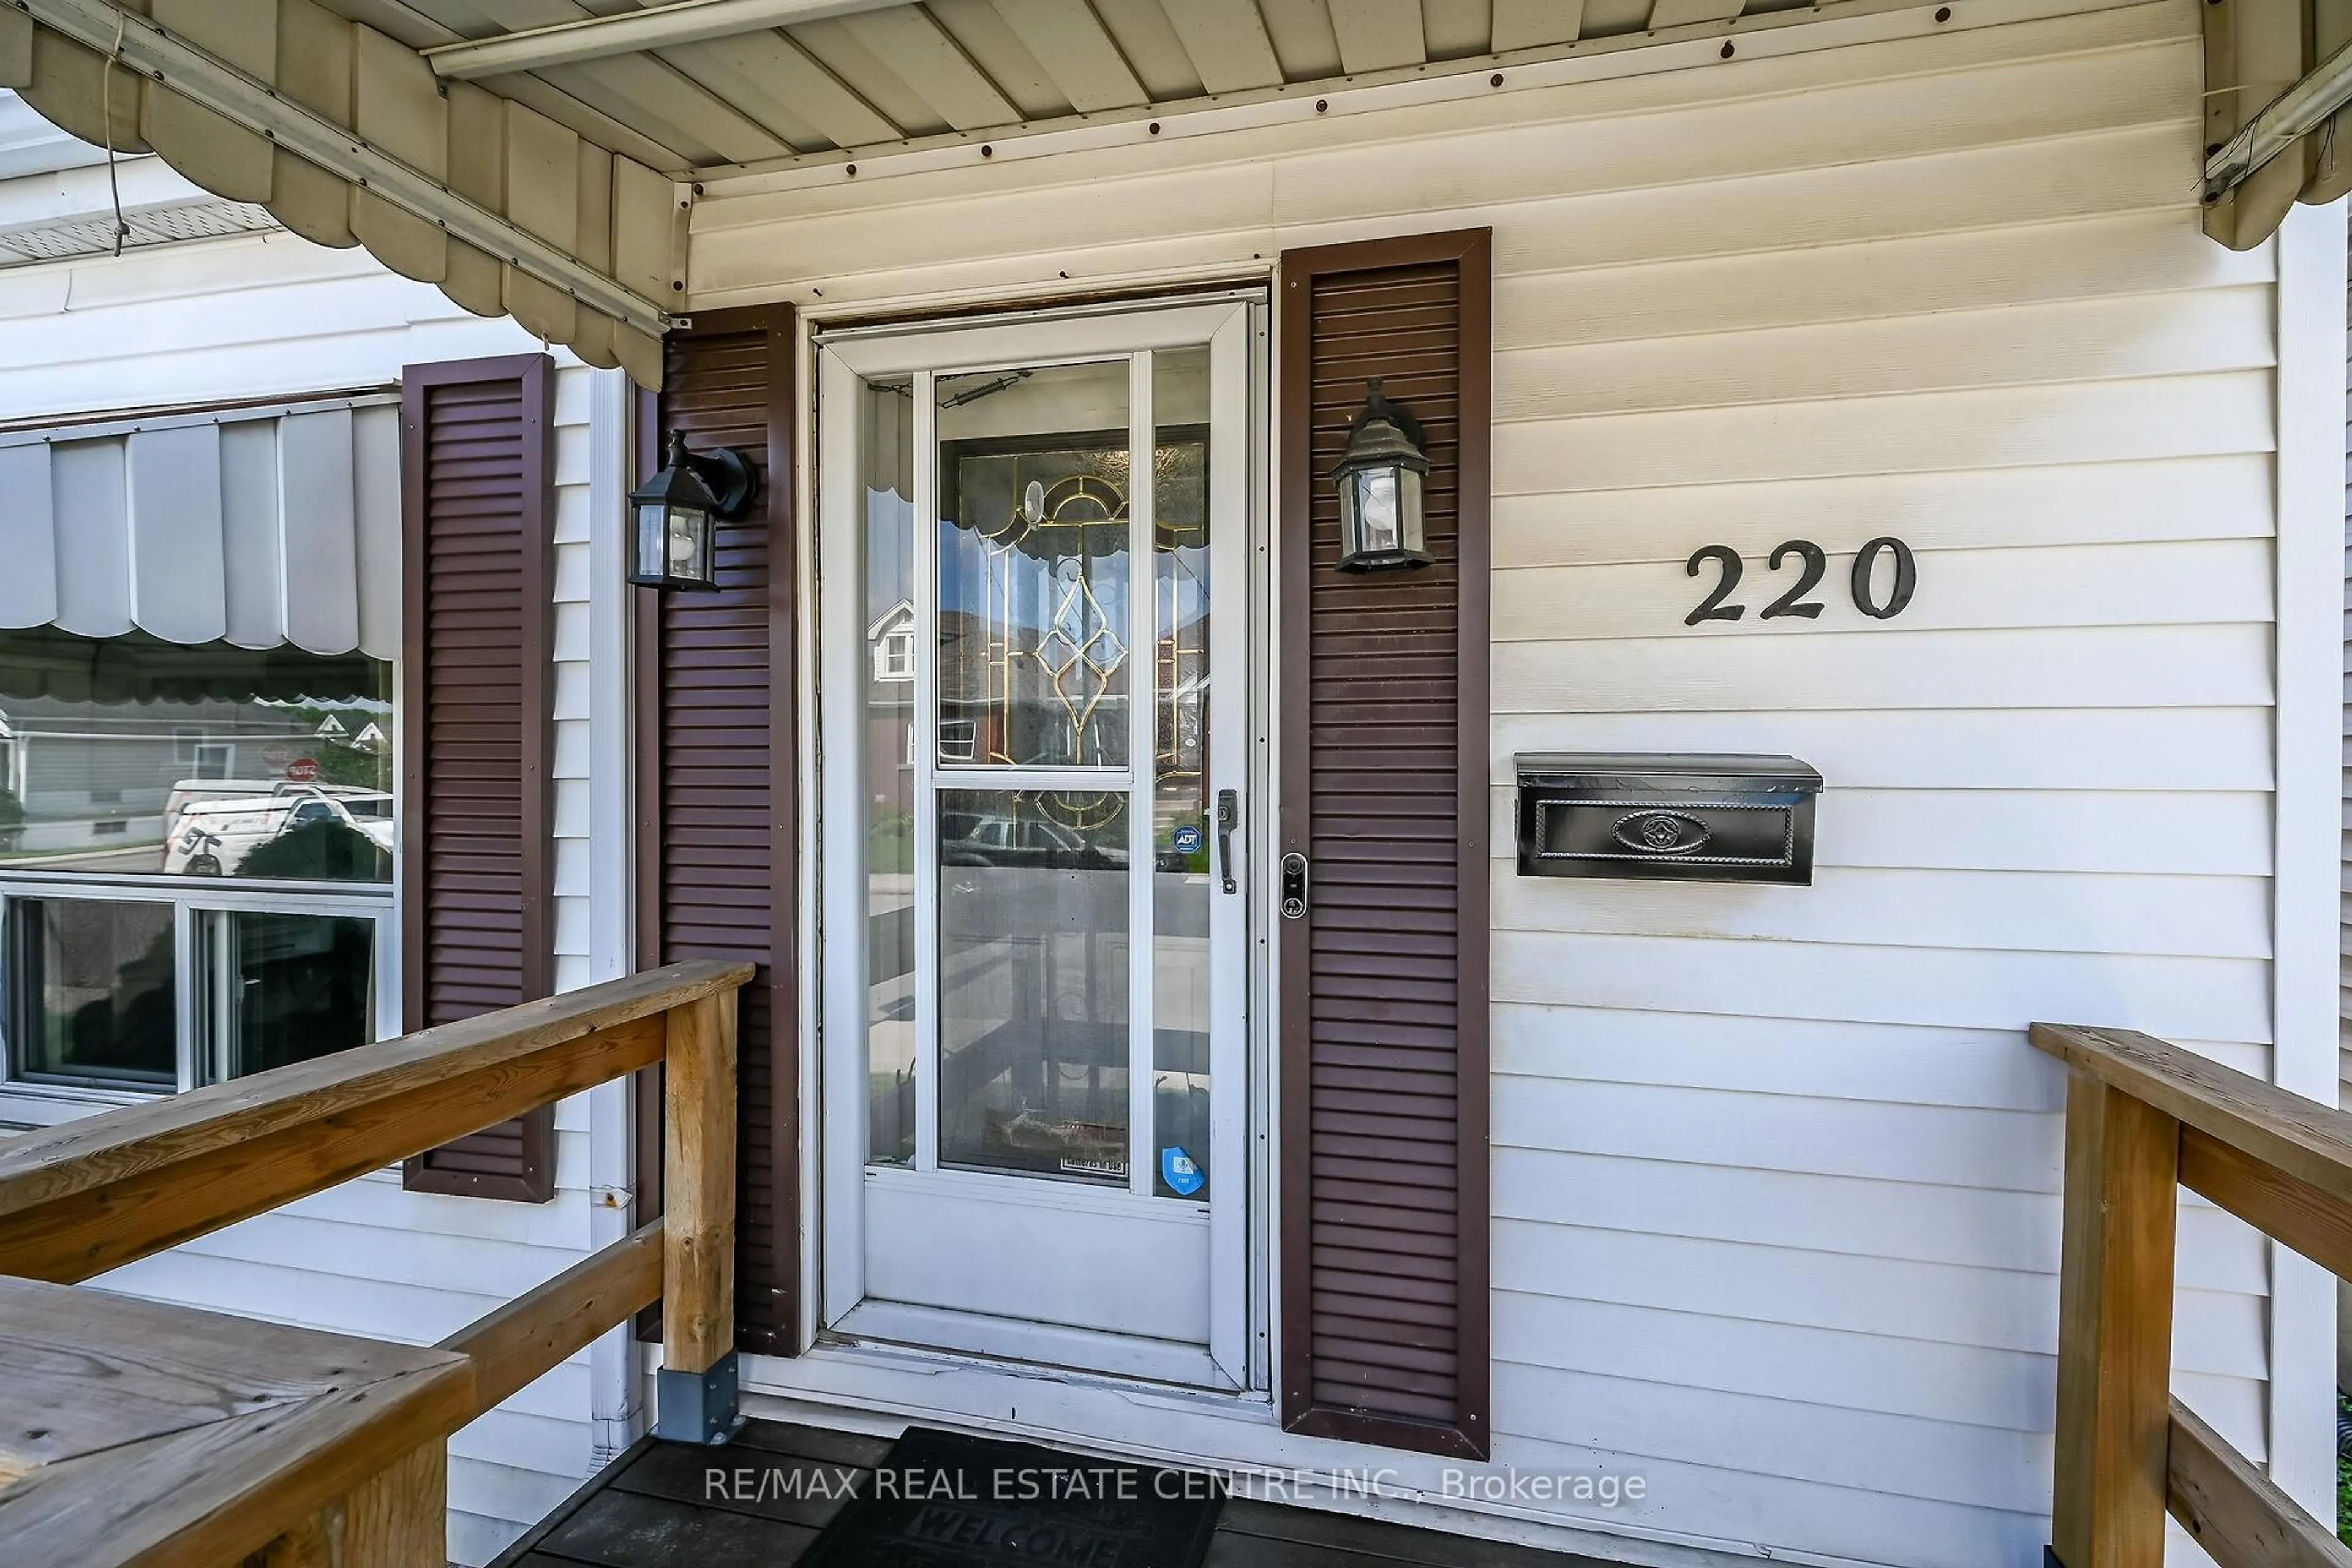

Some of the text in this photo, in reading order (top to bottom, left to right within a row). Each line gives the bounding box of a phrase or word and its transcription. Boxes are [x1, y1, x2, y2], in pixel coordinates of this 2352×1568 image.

[1684, 537, 1917, 626] 220
[1177, 834, 1196, 845] ADT
[917, 1507, 1118, 1568] WELCOME
